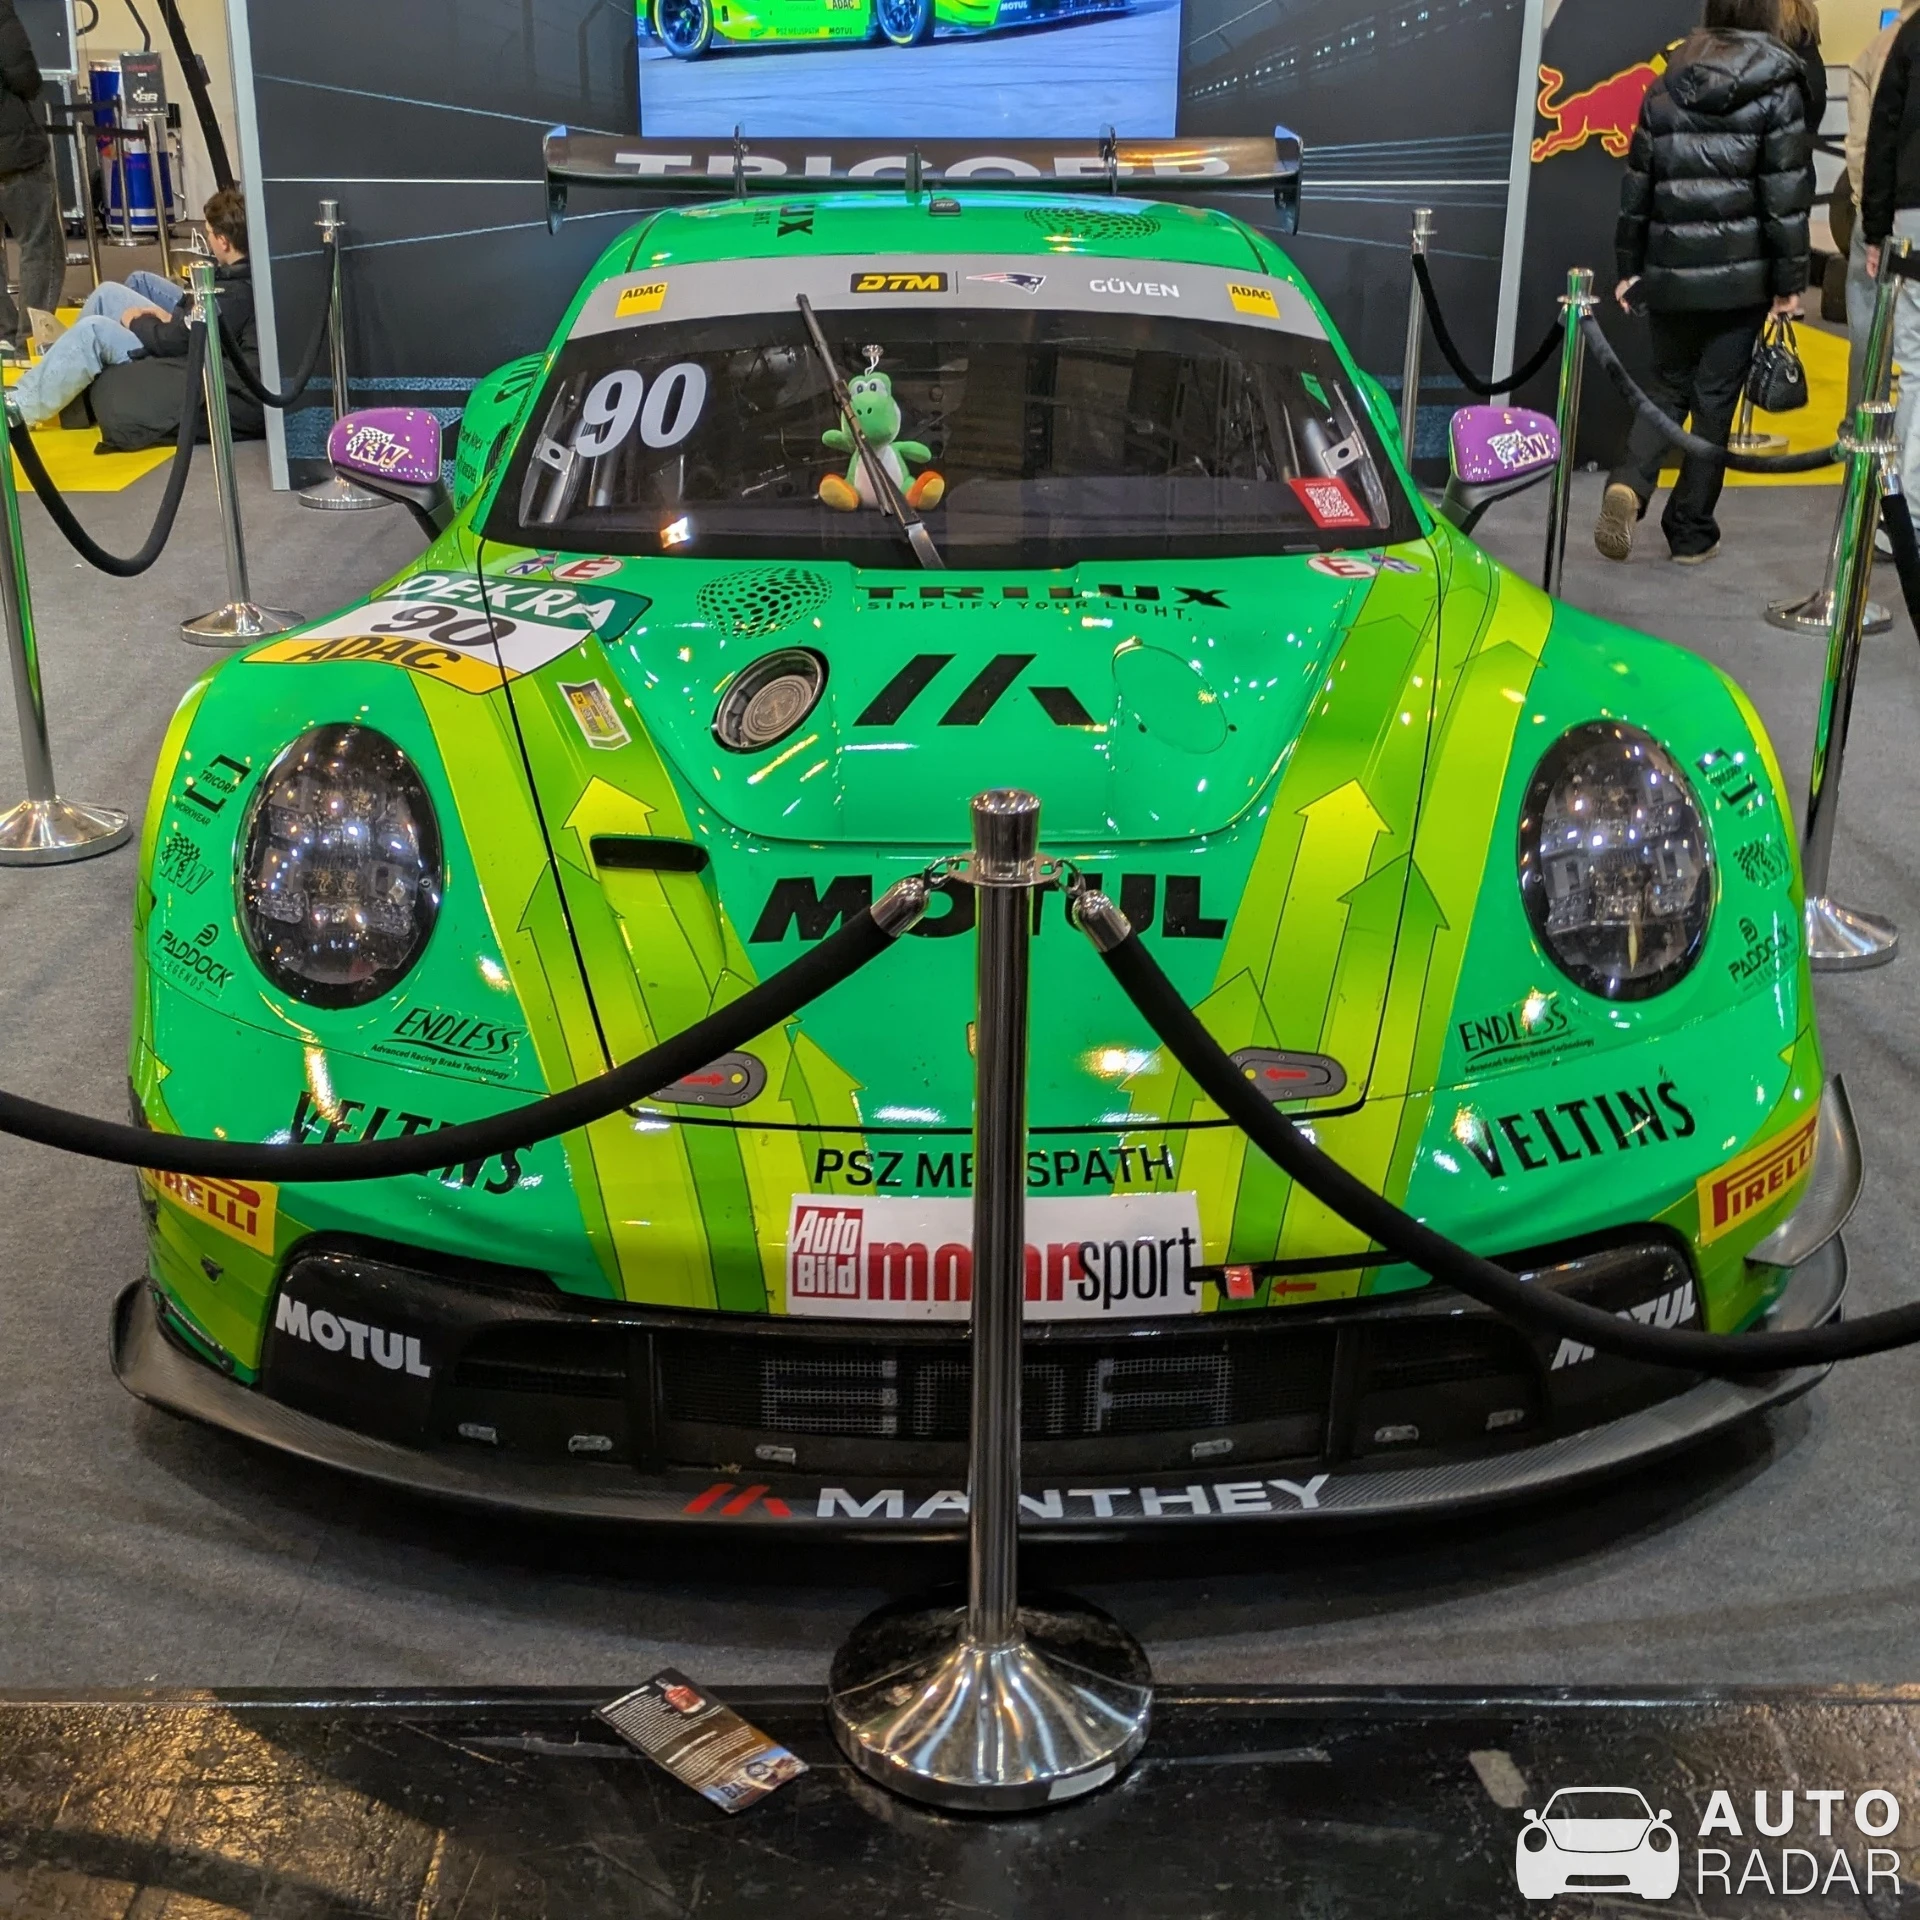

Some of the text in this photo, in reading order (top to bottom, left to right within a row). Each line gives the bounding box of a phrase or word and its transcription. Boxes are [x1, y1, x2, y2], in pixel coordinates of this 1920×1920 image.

[1000, 1, 1028, 11] MOTUL
[828, 27, 853, 35] MOTUL
[622, 283, 665, 300] ADAC
[856, 274, 940, 291] DTM
[1089, 277, 1180, 298] GÜVEN
[1230, 285, 1272, 301] ADAC
[575, 362, 707, 458] 90
[386, 574, 616, 633] DEKRA
[855, 584, 1232, 610] TRILUX
[867, 600, 1194, 622] SIMPLIFY YOUR LIGHT.
[370, 604, 518, 647] 90
[283, 636, 463, 670] ADAC
[199, 769, 237, 795] TRICORP
[173, 799, 213, 828] WORKWEAR
[156, 929, 235, 989] PADDOCK
[161, 960, 205, 992] LEGENDS
[393, 1007, 523, 1055] ENDLESS
[371, 1044, 510, 1081] Advanced Racing Brake Technology
[1461, 1080, 1697, 1181] VELTINS
[814, 1144, 1176, 1189] PSZ MESPATH
[795, 1210, 861, 1256] Auto
[797, 1256, 859, 1296] Bild
[274, 1292, 432, 1379] MOTUL
